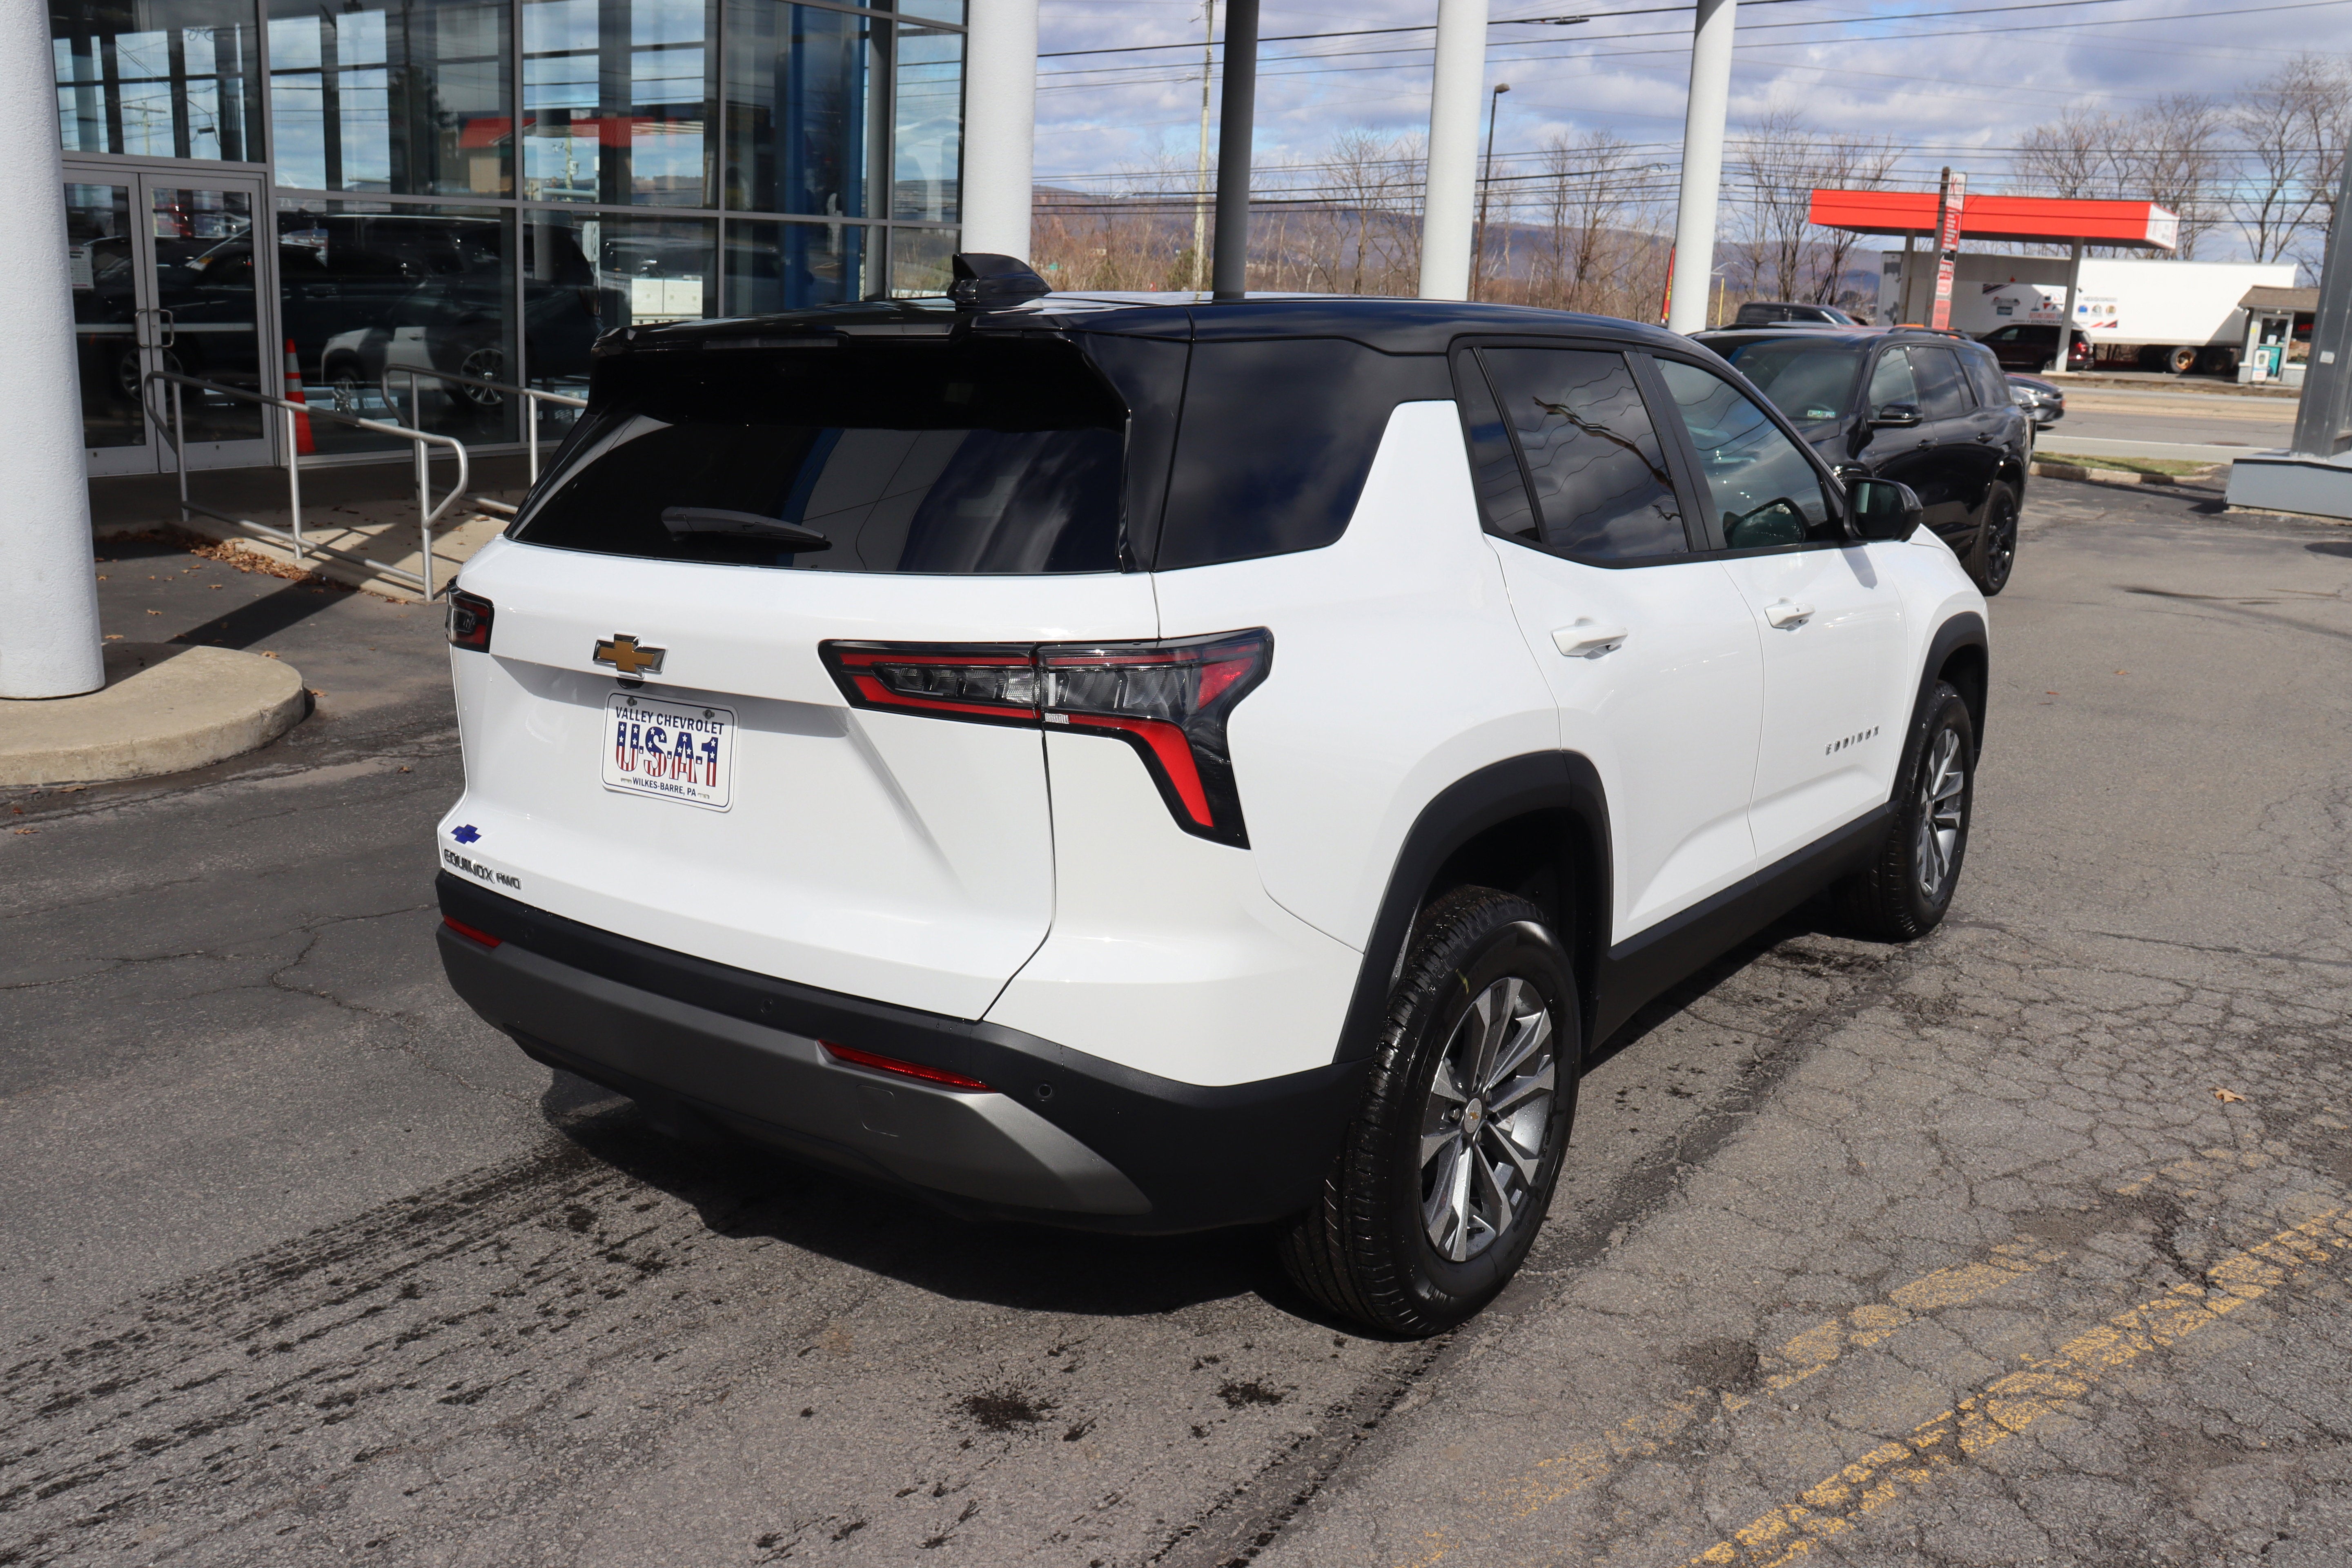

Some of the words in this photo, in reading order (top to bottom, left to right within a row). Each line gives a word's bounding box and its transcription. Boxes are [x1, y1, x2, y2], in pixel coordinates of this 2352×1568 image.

[616, 706, 653, 723] VALLEY
[657, 713, 724, 735] CHEVROLET
[633, 777, 685, 796] WILKES-BARRE,
[687, 788, 696, 796] PA
[444, 849, 495, 884] EQUINOX
[496, 871, 522, 890] AWD
